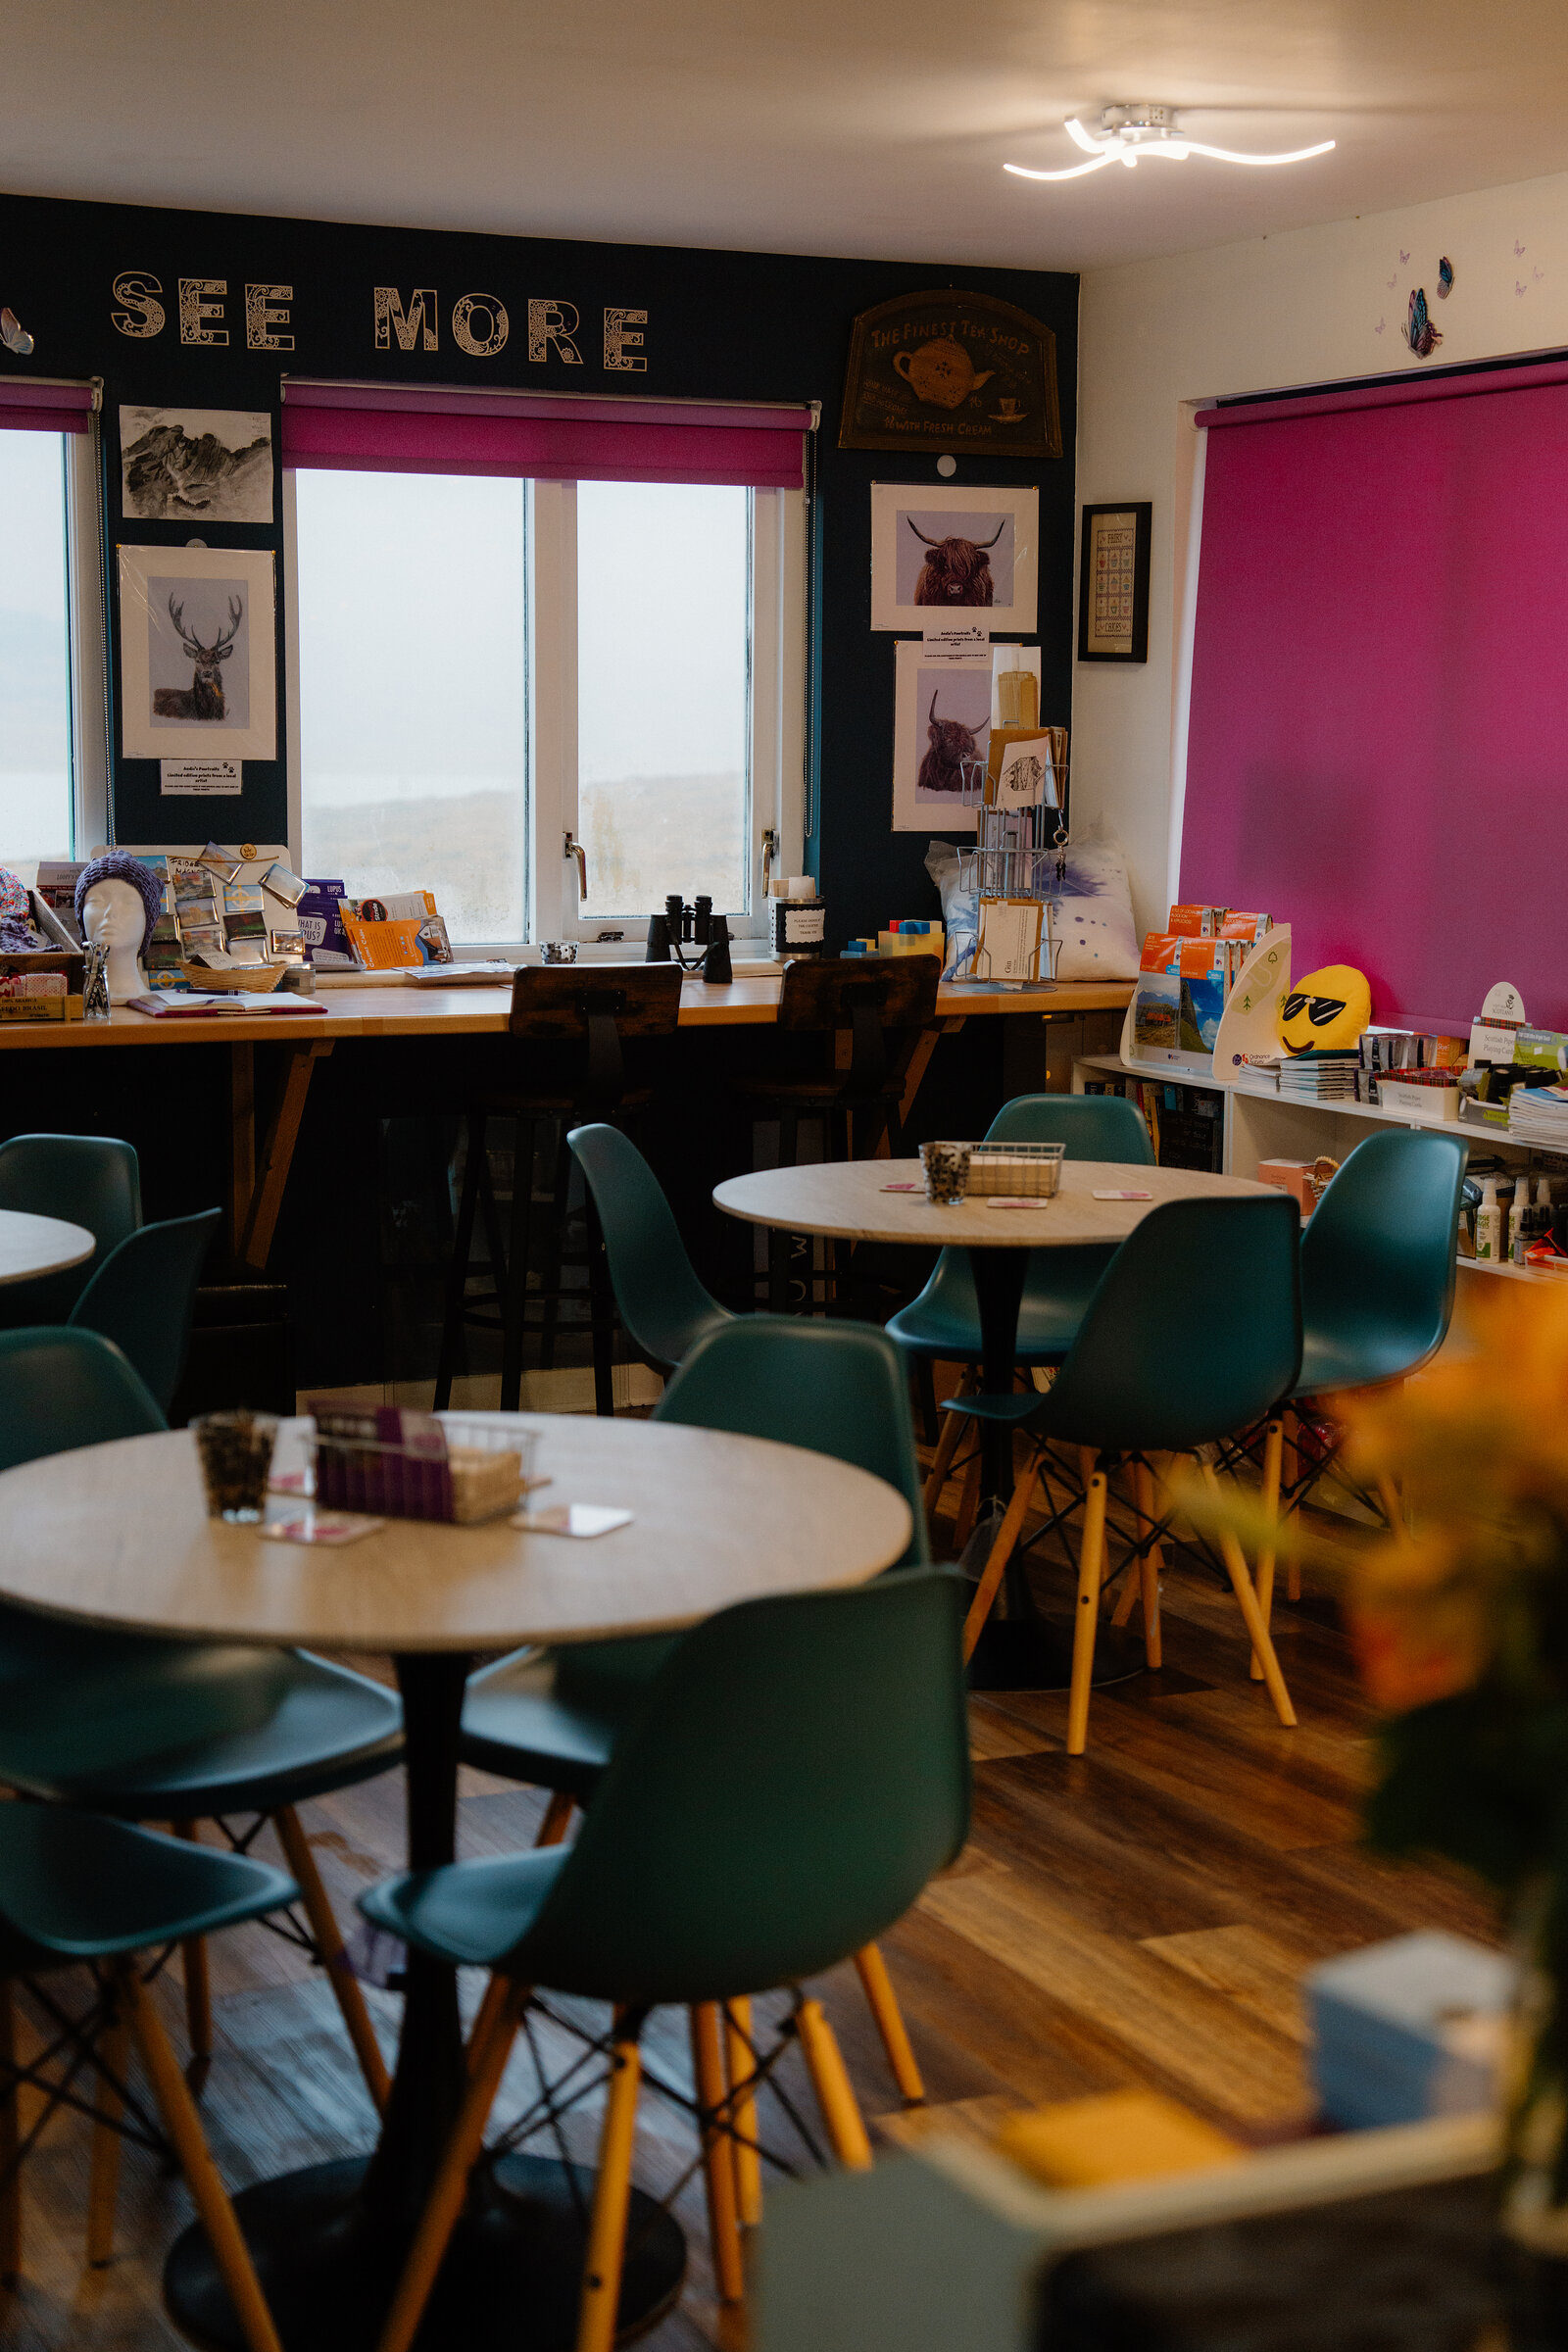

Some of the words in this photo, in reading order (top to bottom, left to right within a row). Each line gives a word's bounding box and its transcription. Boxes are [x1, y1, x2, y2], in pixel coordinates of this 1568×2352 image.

[111, 270, 295, 351] SEE
[373, 287, 648, 371] MORE
[871, 328, 901, 348] THE
[904, 320, 956, 340] FINEST
[961, 319, 986, 339] TEA
[989, 327, 1030, 355] SHOP
[896, 419, 920, 431] WITH
[923, 419, 954, 433] FRESH
[957, 422, 992, 435] CREAM
[1493, 1007, 1513, 1016] SCOTLAND
[1486, 1035, 1503, 1044] Scottish
[1484, 1045, 1501, 1054] Playing
